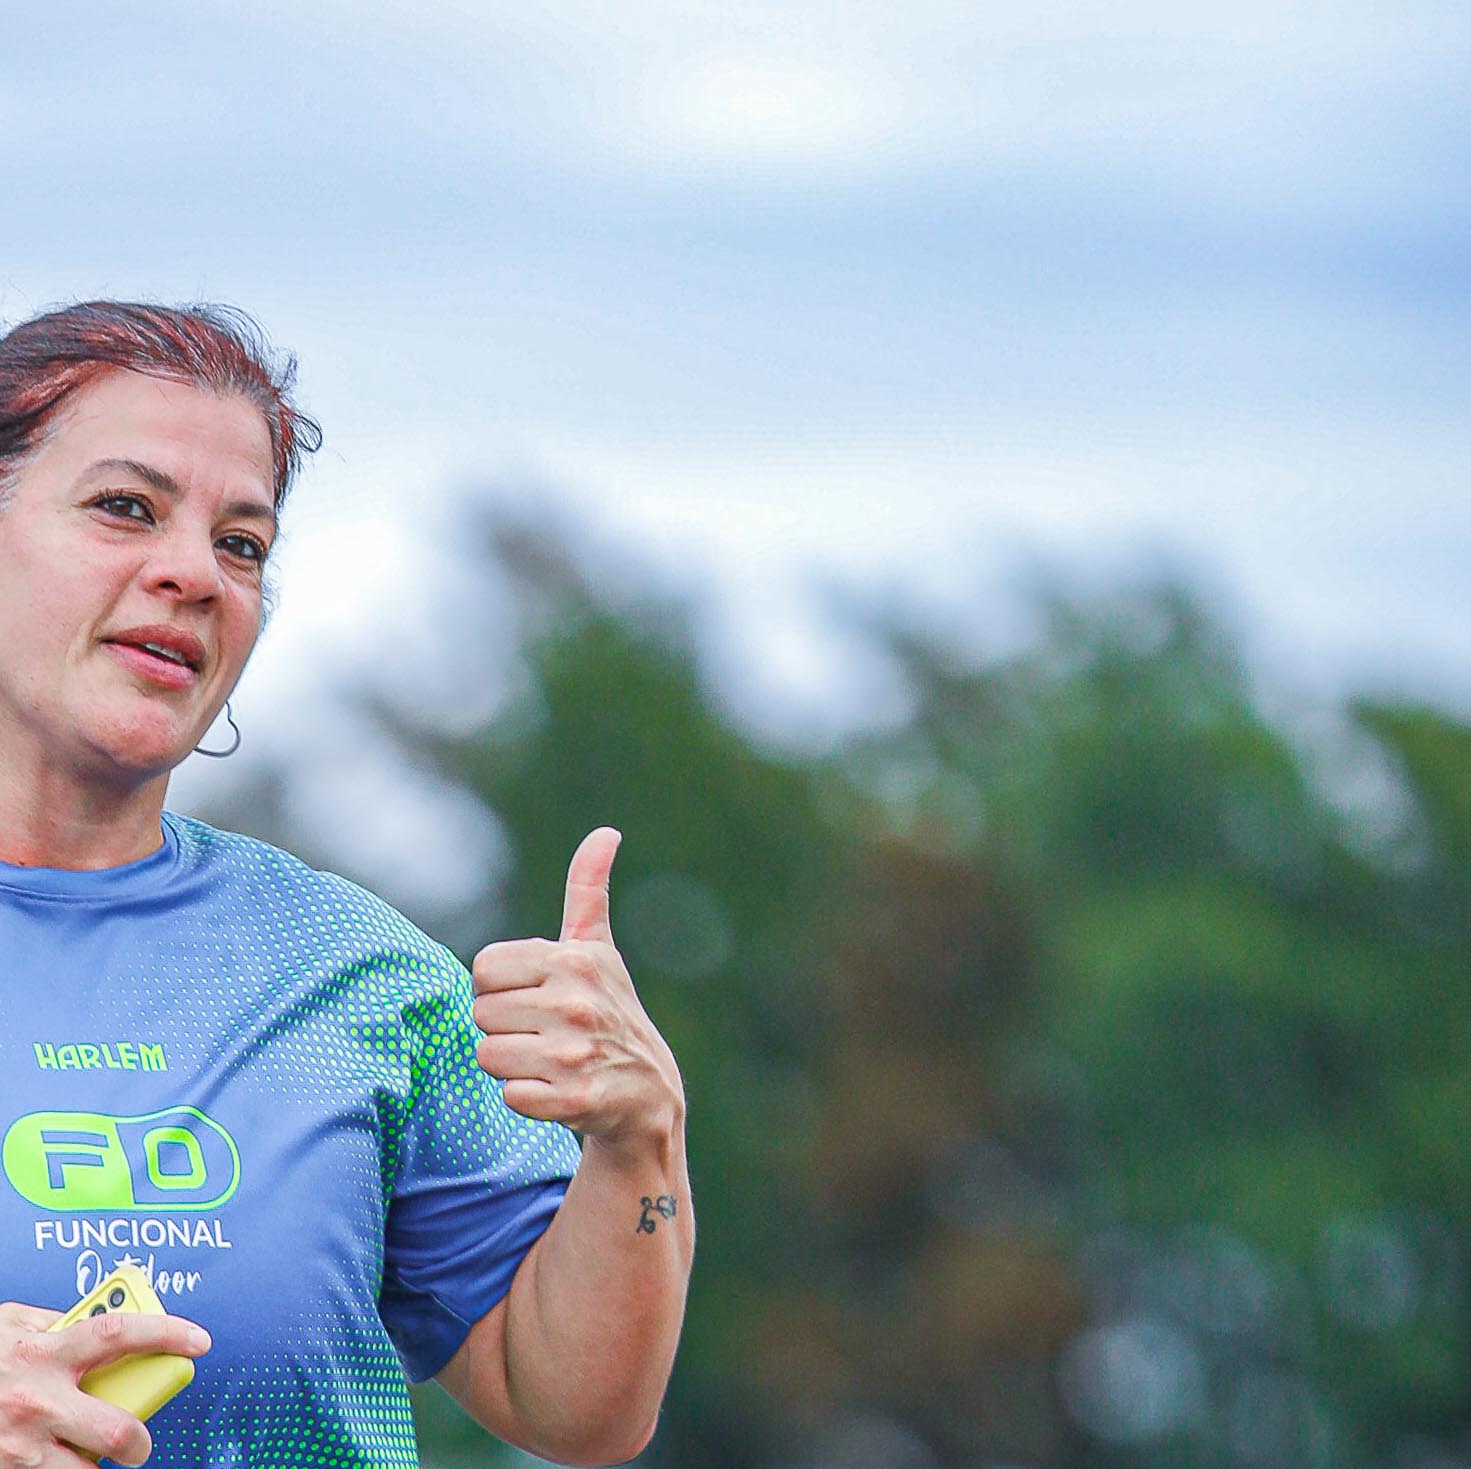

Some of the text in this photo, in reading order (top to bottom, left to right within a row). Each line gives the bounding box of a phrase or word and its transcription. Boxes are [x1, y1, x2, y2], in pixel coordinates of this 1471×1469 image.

[33, 1041, 168, 1071] HARLEM
[40, 1126, 207, 1190] FO
[34, 1217, 232, 1249] FUNCIONAL
